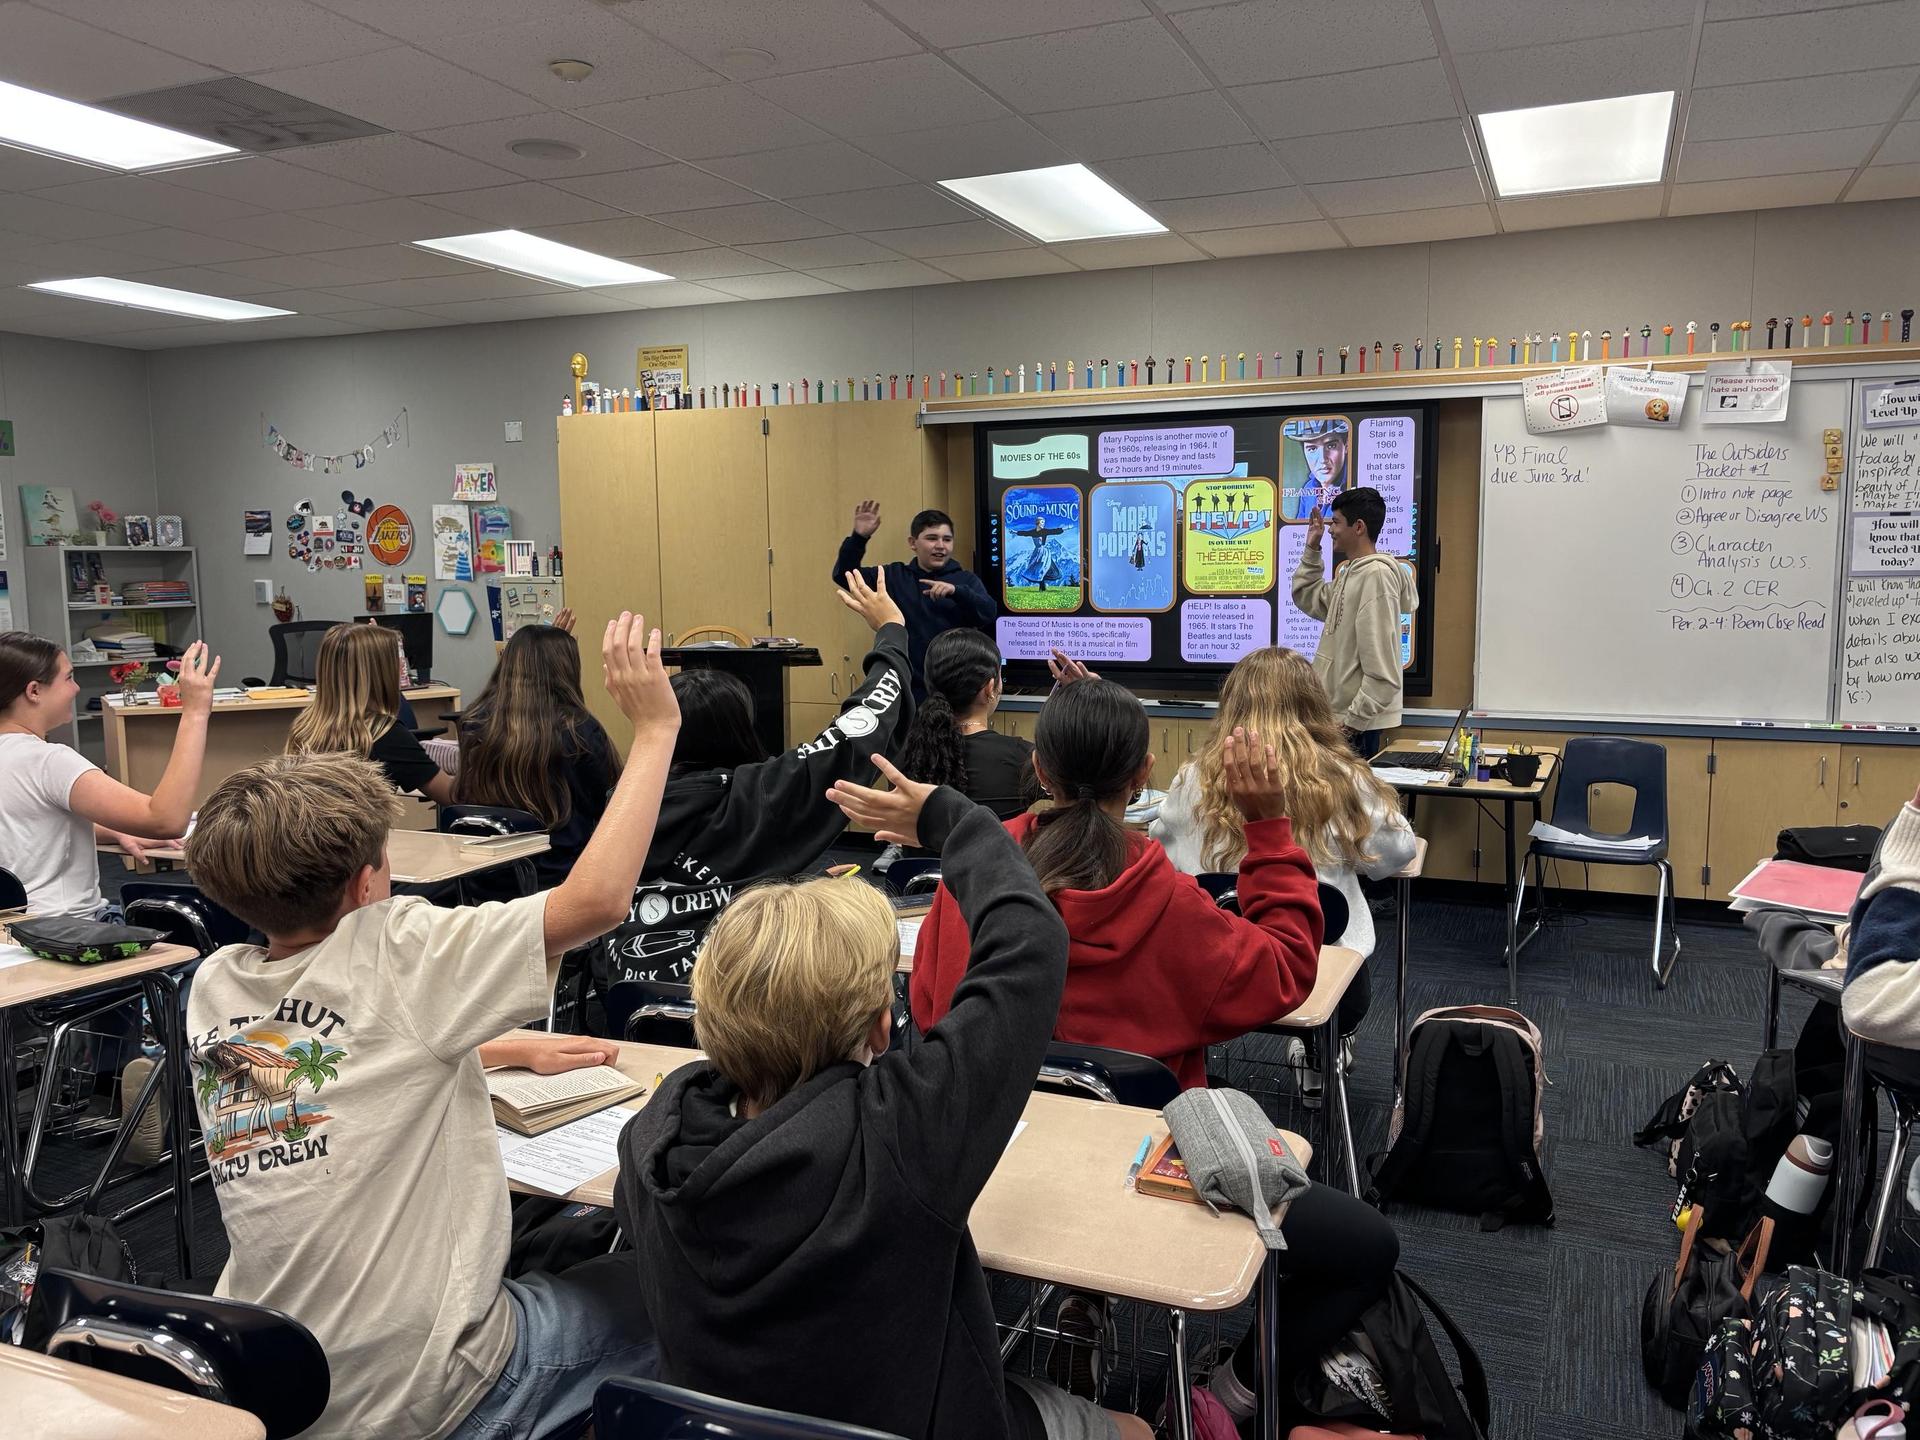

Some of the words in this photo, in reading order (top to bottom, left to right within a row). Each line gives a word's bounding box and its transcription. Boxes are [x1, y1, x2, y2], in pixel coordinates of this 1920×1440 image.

[1732, 385, 1748, 393] and
[1750, 384, 1779, 392] hoods
[1880, 392, 1907, 407] How
[1870, 407, 1898, 418] Level
[1900, 406, 1918, 419] Up
[1370, 419, 1404, 428] Flaming
[1103, 436, 1122, 444] Mary
[1124, 435, 1154, 444] Poppins
[1164, 432, 1193, 441] another
[1220, 430, 1228, 438] of
[1369, 430, 1387, 438] Star
[1389, 430, 1396, 438] is
[1860, 434, 1878, 448] We
[1883, 433, 1904, 446] will
[1103, 446, 1116, 454] the
[1118, 445, 1142, 454] 1960s,
[1143, 444, 1178, 453] releasing
[1190, 442, 1210, 450] 1964.
[1376, 440, 1397, 449] 1960
[1000, 453, 1032, 462] MOVIES
[1034, 453, 1046, 461] OF
[1048, 452, 1065, 460] THE
[1066, 451, 1081, 460] 60s
[1120, 455, 1141, 463] made
[1142, 454, 1152, 463] by
[1154, 453, 1180, 463] Disney
[1181, 452, 1196, 460] and
[1198, 452, 1216, 460] lasts
[1373, 451, 1399, 460] movie
[1494, 443, 1517, 465] YB
[1522, 445, 1568, 465] Final
[1688, 443, 1717, 462] The
[1722, 442, 1791, 461] Outsiders
[1855, 450, 1899, 467] today
[1903, 450, 1916, 466] by
[1103, 466, 1114, 474] for
[1144, 464, 1159, 472] and
[1366, 462, 1383, 471] that
[1384, 462, 1406, 470] stars
[1696, 462, 1745, 478] Packet
[1750, 462, 1770, 476] #1
[1369, 473, 1383, 481] the
[1385, 473, 1401, 481] star
[1490, 467, 1518, 484] due
[1523, 468, 1557, 484] June
[1561, 467, 1590, 484] 3rd!
[1858, 465, 1910, 482] inspired
[455, 472, 496, 492] MAYER
[1375, 483, 1396, 492] Elvis
[1855, 480, 1893, 493] beauty
[1895, 479, 1908, 491] of
[1699, 486, 1726, 501] Intro
[1732, 486, 1755, 500] note
[1761, 487, 1793, 507] page
[1862, 490, 1900, 502] Maybe
[1005, 502, 1037, 523] SOUND
[1046, 501, 1079, 522] MUSIC
[1863, 500, 1898, 511] Maybe
[1112, 505, 1158, 532] MARY
[1189, 509, 1272, 531] HELP!
[1695, 506, 1729, 528] Agree
[1729, 511, 1742, 521] or
[1745, 507, 1802, 528] Disagree
[1805, 505, 1828, 523] WS
[1386, 526, 1403, 534] and
[1871, 519, 1898, 531] How
[1900, 519, 1919, 529] will
[370, 525, 410, 545] LAKERS
[1292, 532, 1305, 540] Bye
[1869, 532, 1898, 543] know
[1900, 532, 1920, 542] that
[1695, 534, 1772, 552] Character
[1868, 544, 1909, 554] Leveled
[1196, 551, 1216, 562] THE
[1218, 550, 1265, 561] BEATLES
[1697, 551, 1760, 574] Analysis
[1880, 557, 1915, 568] today?
[1693, 579, 1720, 596] Ch.
[1723, 580, 1734, 597] 2
[1743, 580, 1779, 596] CER
[1847, 580, 1854, 592] I
[1857, 579, 1876, 592] will
[1881, 578, 1904, 591] know
[1187, 602, 1212, 610] HELP!
[1222, 602, 1239, 610] also
[1017, 620, 1040, 628] Sound
[1188, 622, 1209, 630] 1965.
[1239, 622, 1254, 630] The
[1672, 615, 1695, 631] Per.
[1732, 613, 1765, 630] Poem
[1766, 612, 1795, 631] Close
[1797, 611, 1826, 630] Read
[1848, 614, 1880, 627] when
[1886, 612, 1896, 626] I
[1015, 630, 1045, 638] released
[1091, 631, 1131, 639] specifically
[1187, 632, 1216, 640] Beatles
[1217, 632, 1232, 640] and
[1845, 632, 1888, 650] details
[1088, 640, 1115, 648] musical
[1116, 640, 1123, 648] in
[1125, 640, 1138, 648] film
[1187, 642, 1198, 650] for
[1211, 642, 1229, 650] hour
[1230, 642, 1240, 650] 32
[1108, 650, 1126, 659] long.
[1847, 653, 1870, 668] but
[1874, 652, 1898, 665] also
[1846, 671, 1860, 688] by
[1867, 670, 1892, 684] how
[671, 885, 733, 914] CREW
[624, 967, 658, 981] RISK
[273, 997, 346, 1038] HUT
[258, 1134, 329, 1171] CREW
